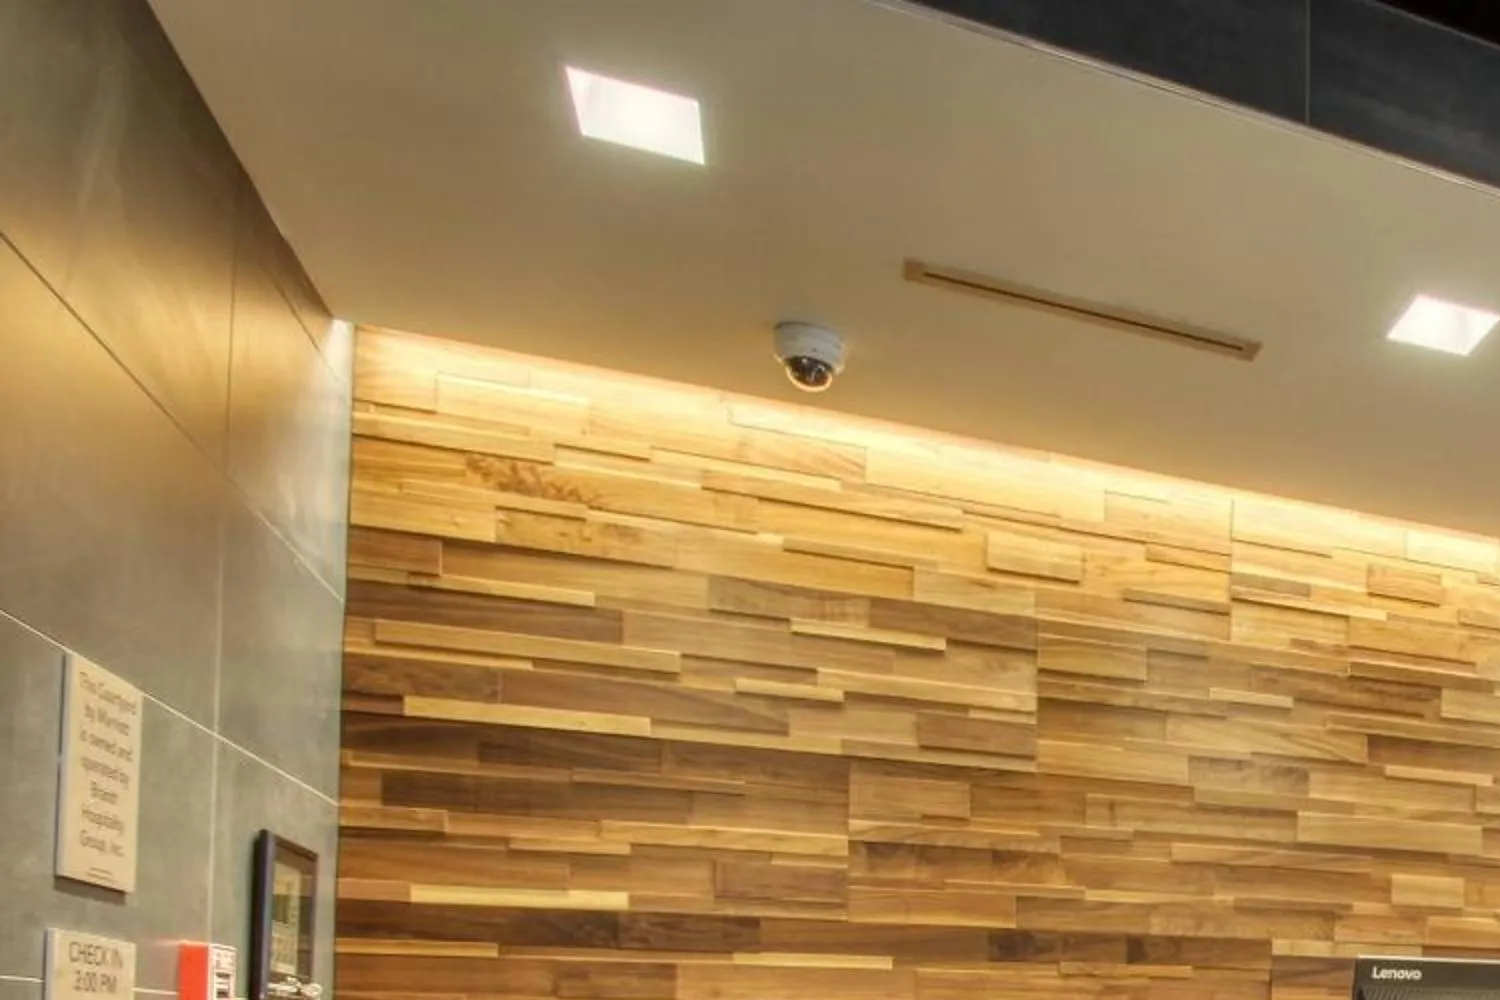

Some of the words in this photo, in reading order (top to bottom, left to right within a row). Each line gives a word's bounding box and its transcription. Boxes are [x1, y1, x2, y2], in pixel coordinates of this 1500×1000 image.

[69, 941, 110, 966] CHECK
[110, 946, 124, 969] IN
[99, 972, 118, 993] PM
[1370, 965, 1423, 980] Lenovo
